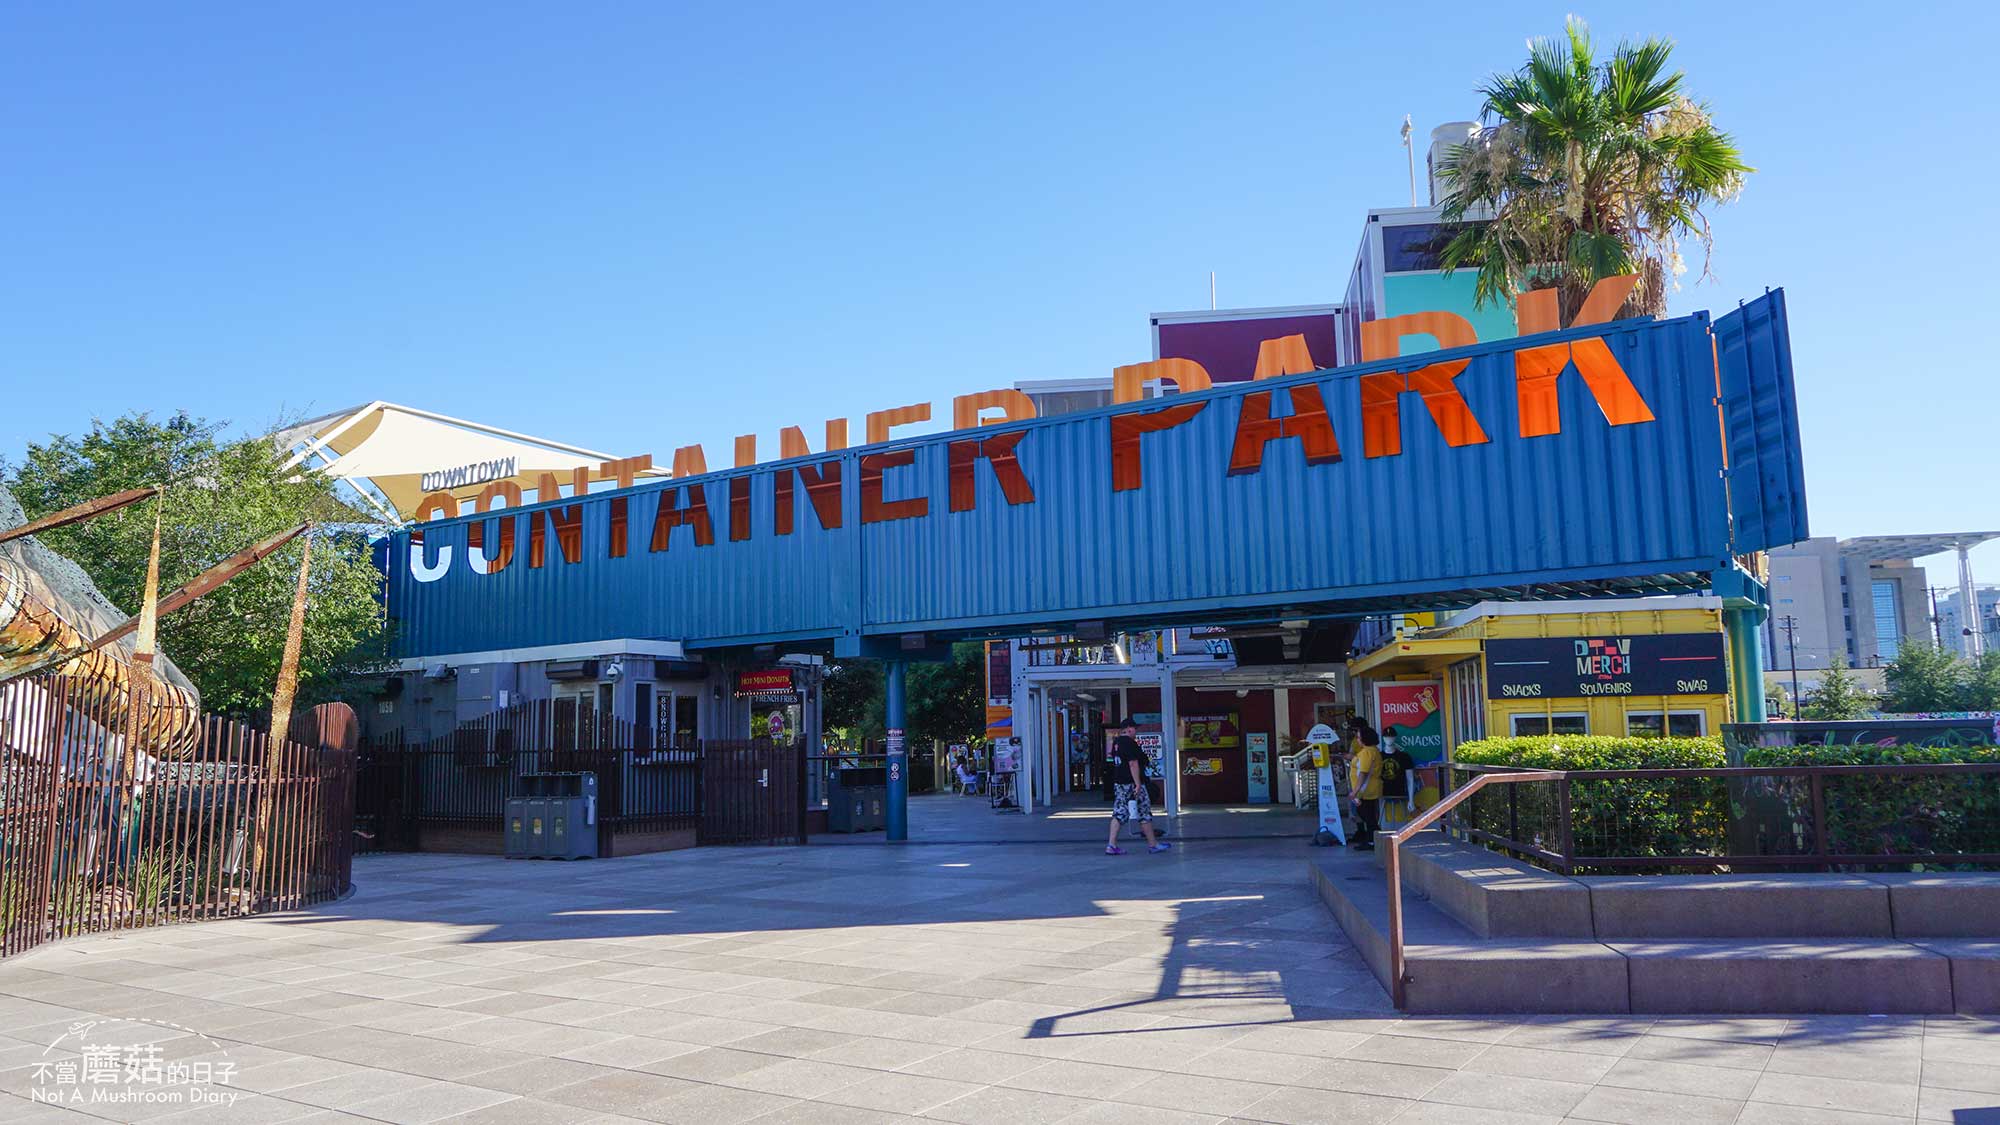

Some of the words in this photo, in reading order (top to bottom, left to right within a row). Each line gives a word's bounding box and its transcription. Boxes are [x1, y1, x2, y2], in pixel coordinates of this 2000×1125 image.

[410, 388, 1036, 583] CONTAINER
[1112, 273, 1656, 492] PARK
[421, 456, 515, 492] DOWNTOWN
[1575, 638, 1631, 656] DTLV
[1577, 655, 1631, 676] MERCH
[1502, 683, 1541, 696] SNACKS
[1580, 682, 1632, 695] SOUVENIRS
[1677, 680, 1708, 692] SWAG
[755, 695, 780, 703] FRENCH
[780, 695, 798, 703] FRIES
[1383, 702, 1419, 714] DRINKS
[1401, 735, 1441, 747] SNACKS
